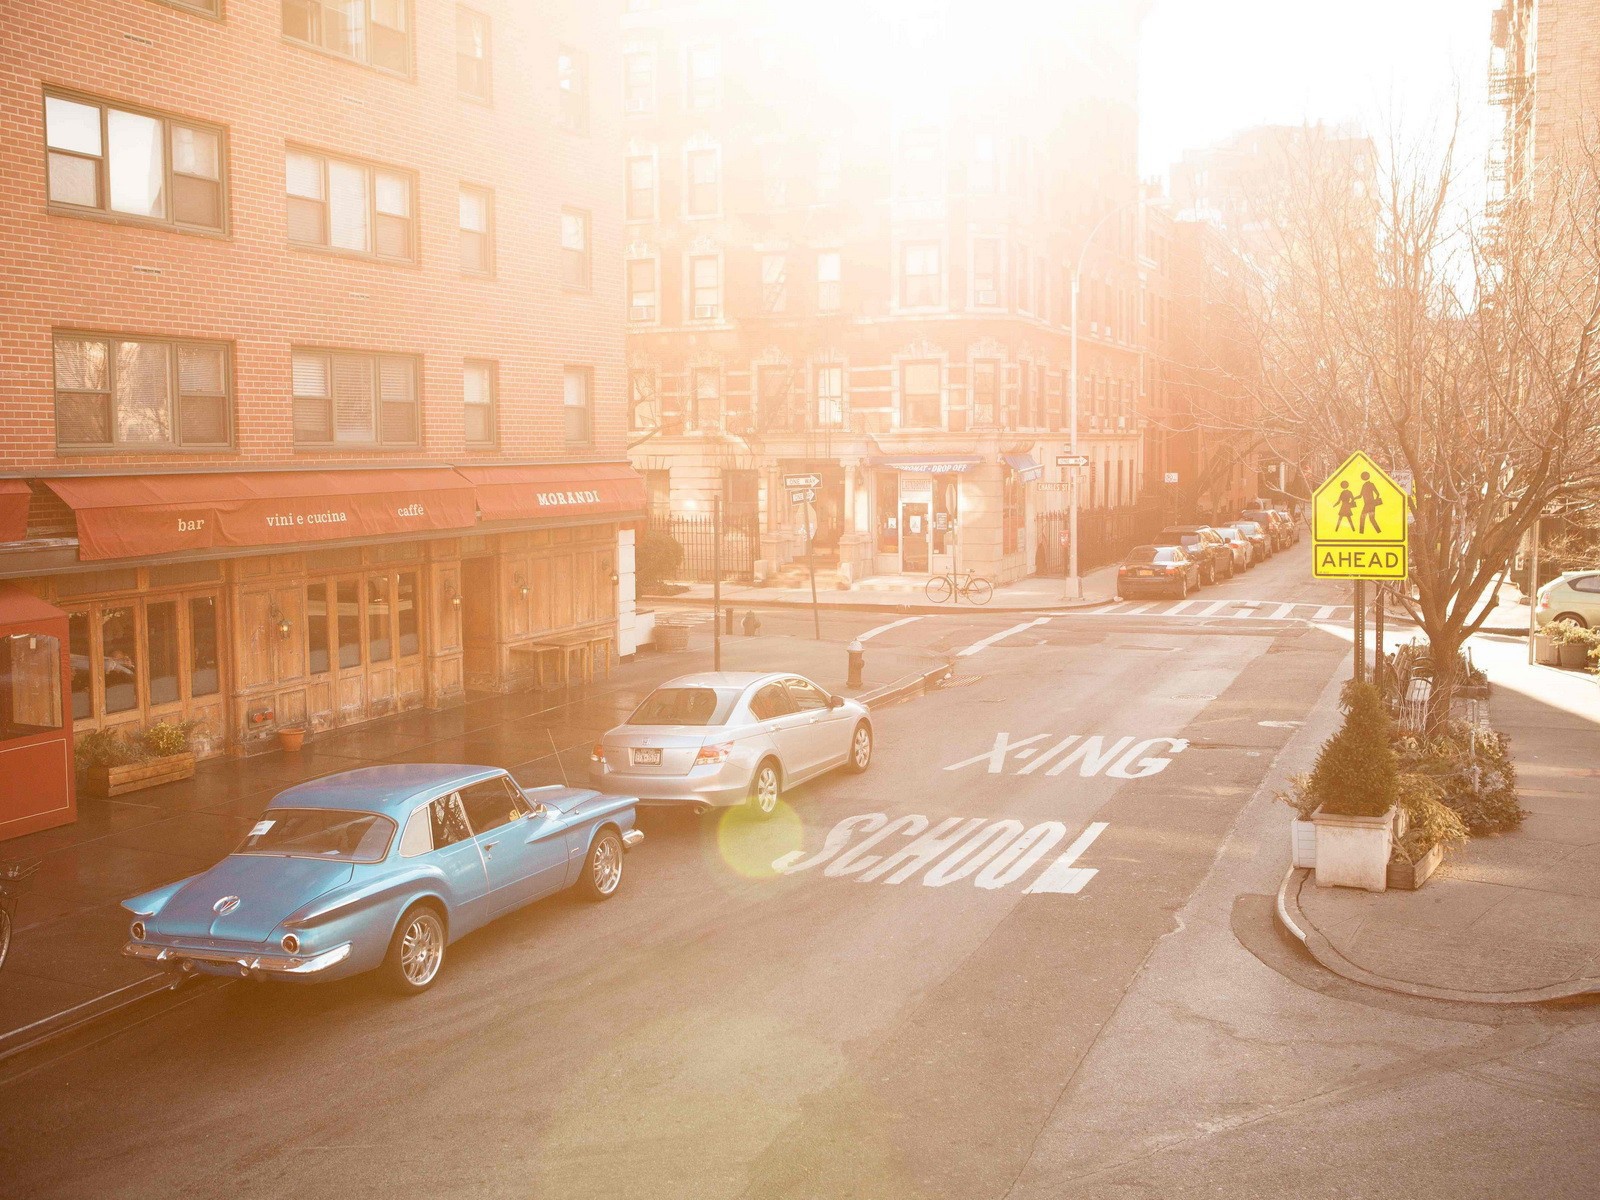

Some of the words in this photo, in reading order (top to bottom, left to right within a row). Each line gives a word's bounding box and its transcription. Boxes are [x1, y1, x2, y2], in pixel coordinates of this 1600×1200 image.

[931, 464, 952, 473] DROP
[952, 463, 968, 472] OFF
[1038, 483, 1060, 491] CHARLES
[536, 490, 601, 507] MORANDI
[794, 493, 803, 501] ONE
[397, 503, 425, 518] caffè
[177, 518, 205, 532] bar
[266, 512, 294, 527] vini
[296, 514, 304, 525] e
[306, 510, 347, 525] cucina
[1321, 552, 1399, 568] AHEAD
[942, 732, 1191, 779] X-ING
[772, 812, 1110, 894] SCHOOL
